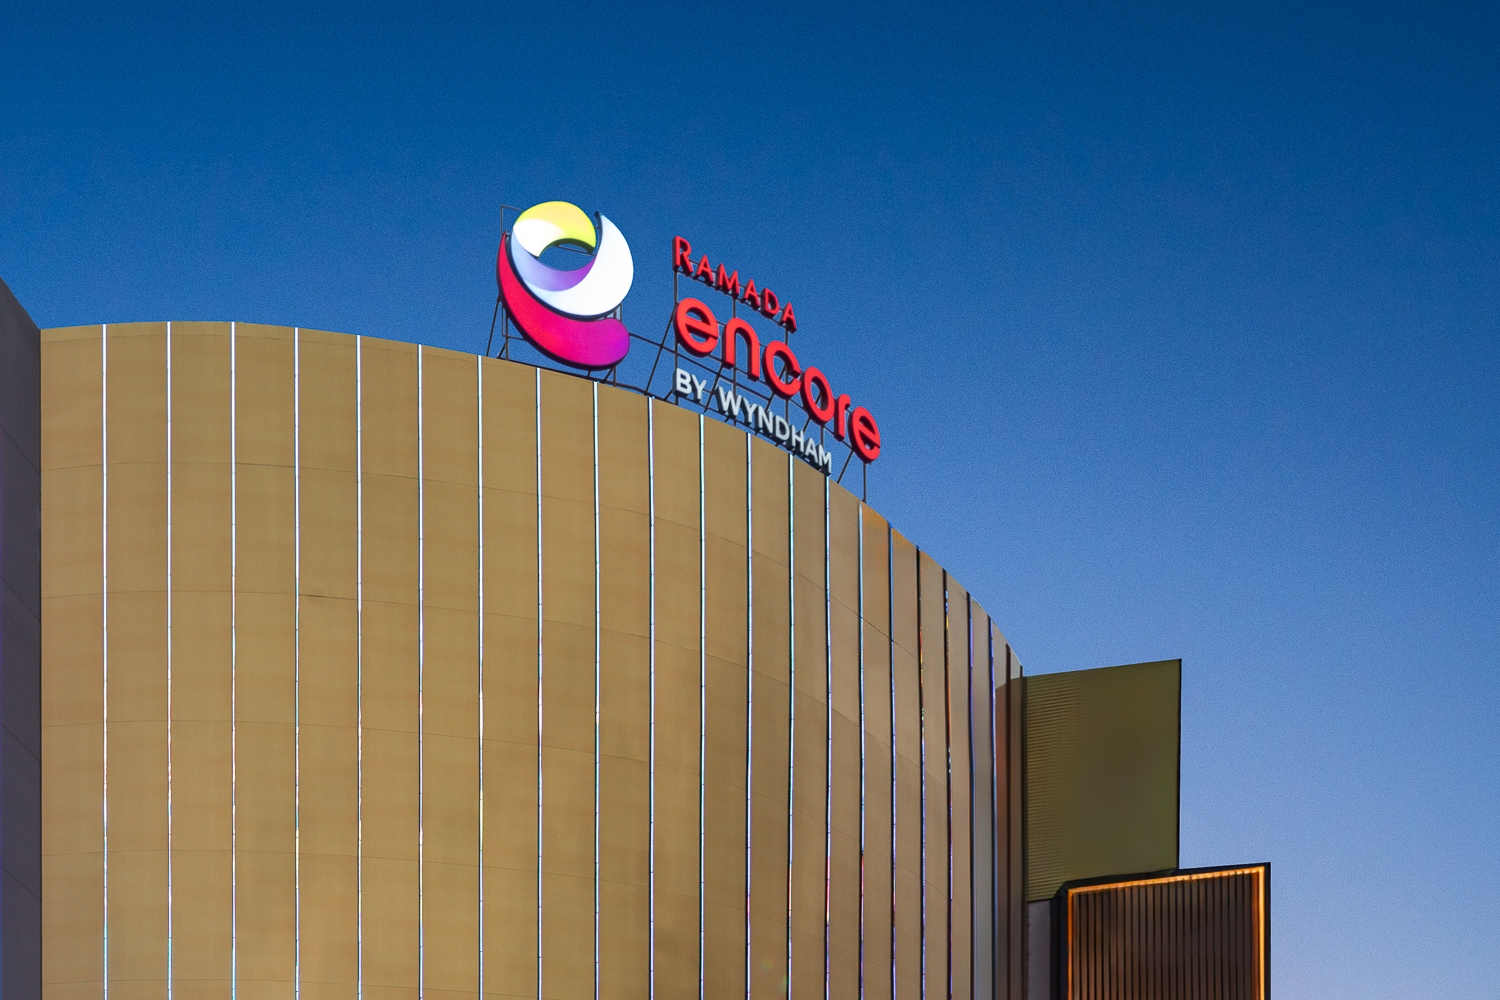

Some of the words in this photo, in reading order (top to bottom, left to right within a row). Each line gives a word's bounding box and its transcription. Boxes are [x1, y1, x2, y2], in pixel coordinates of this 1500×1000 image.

[672, 236, 797, 333] RAMADA
[673, 298, 881, 463] encore
[674, 367, 707, 400] BY
[716, 386, 832, 475] WYNDHAM
